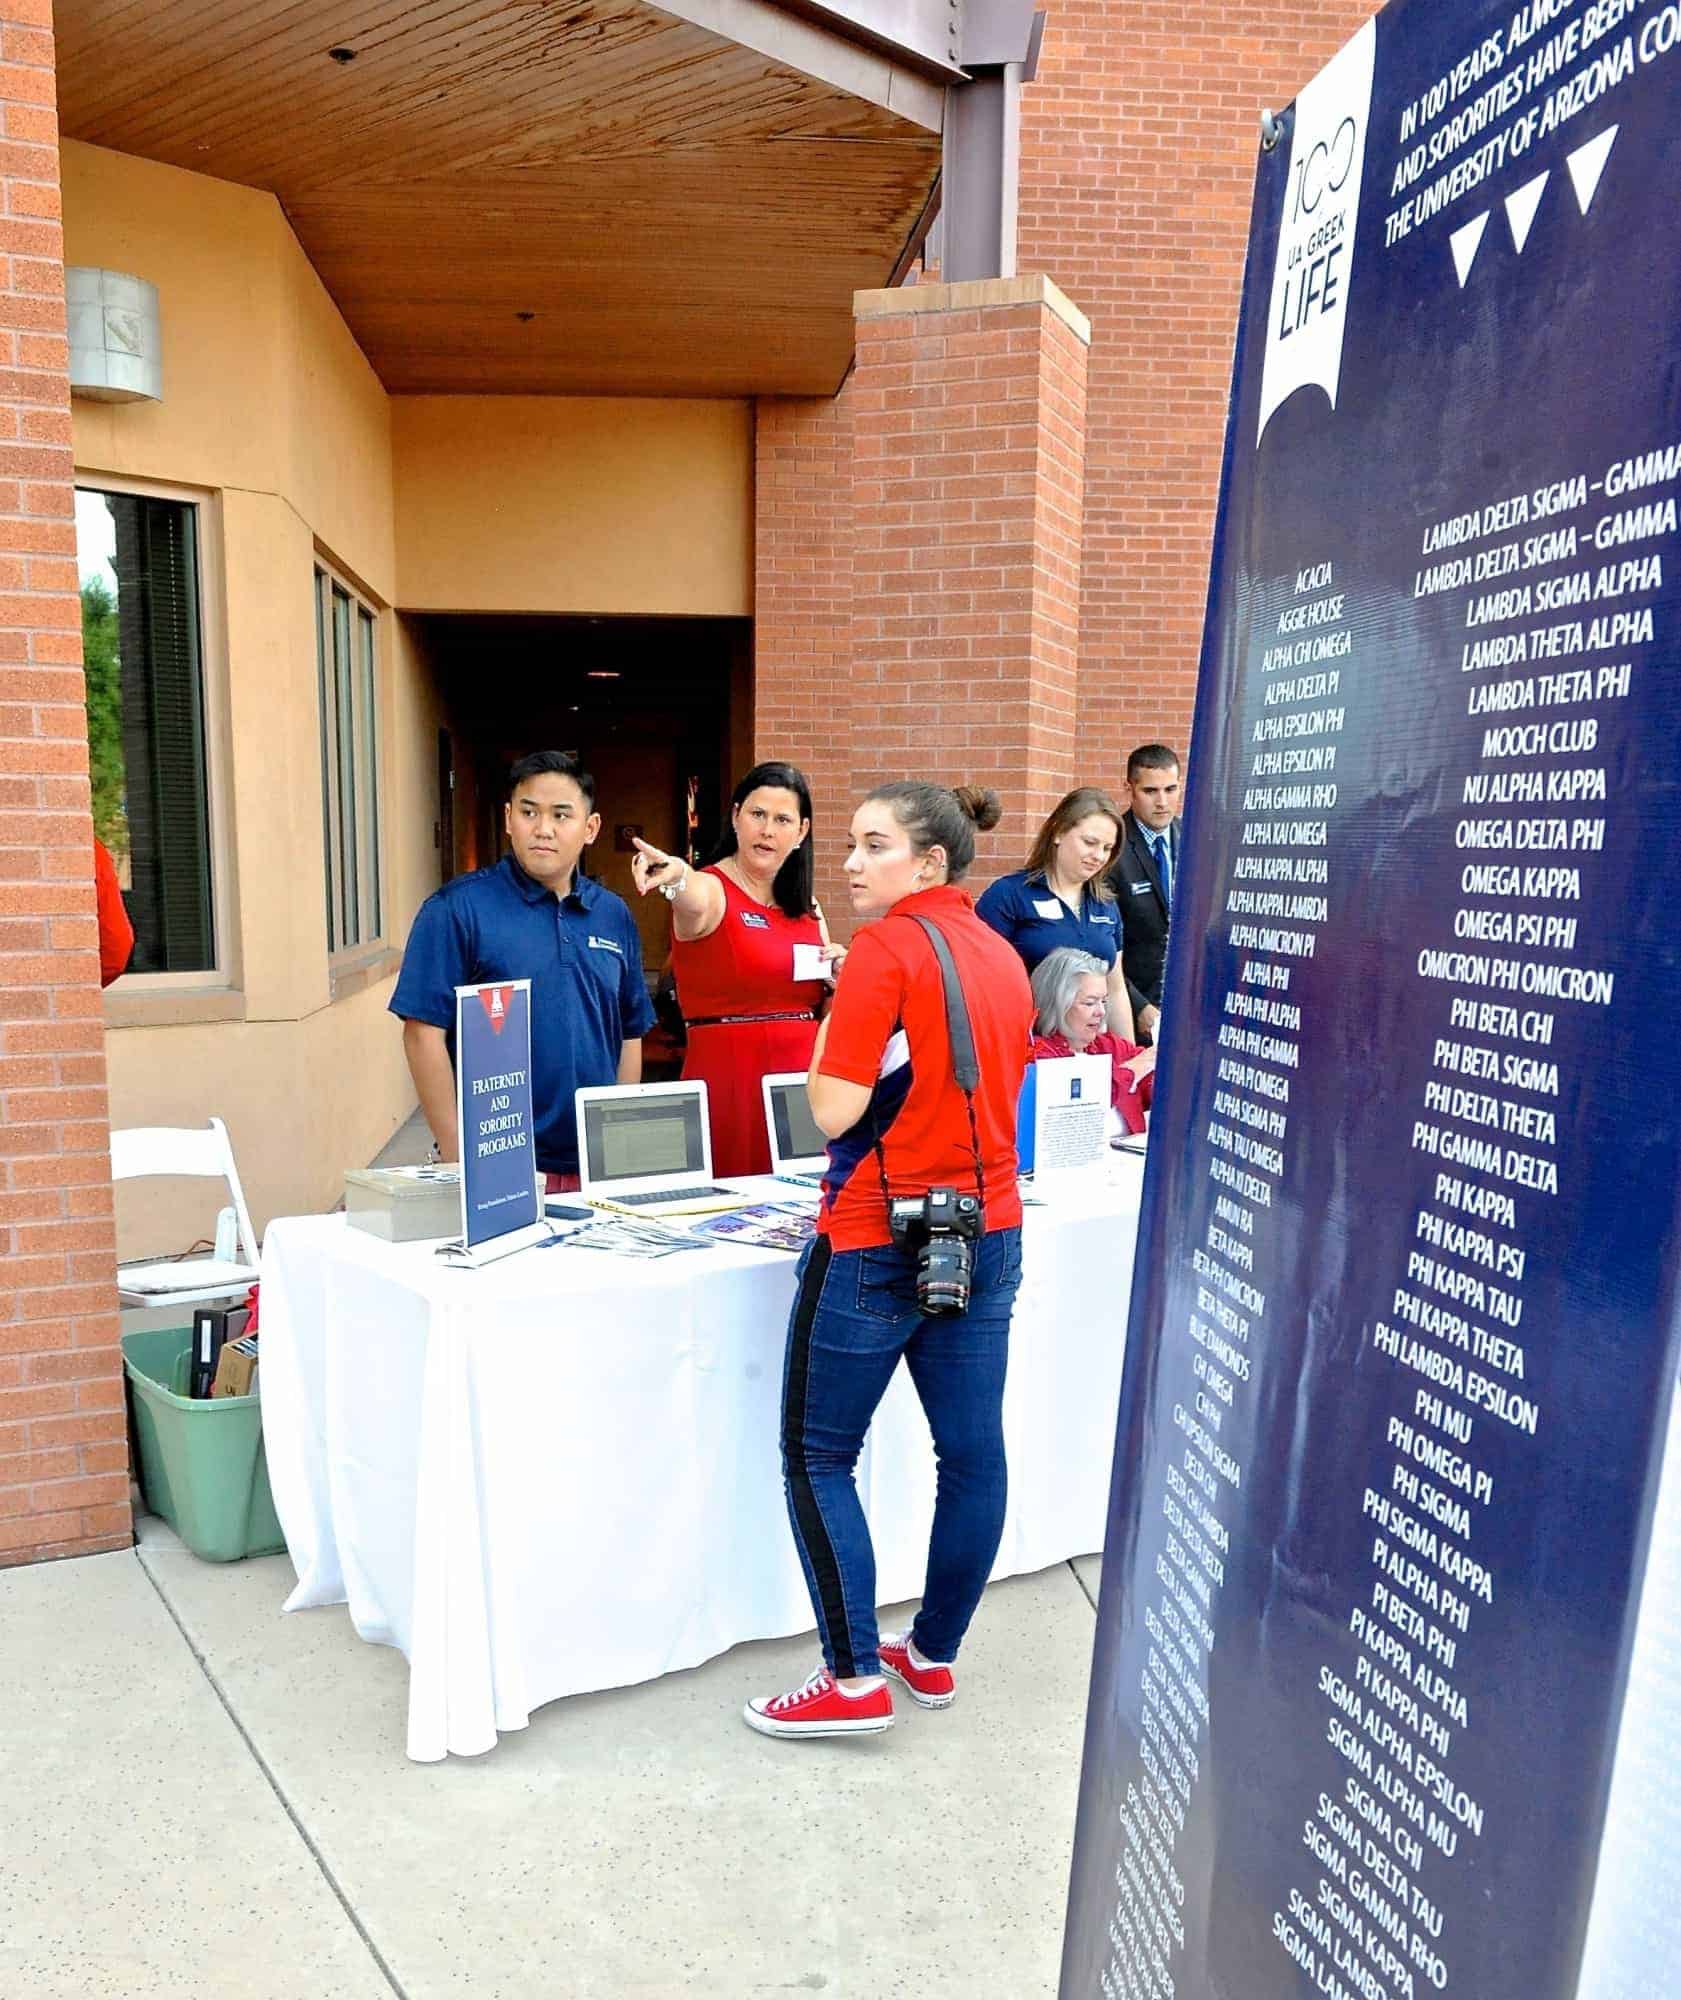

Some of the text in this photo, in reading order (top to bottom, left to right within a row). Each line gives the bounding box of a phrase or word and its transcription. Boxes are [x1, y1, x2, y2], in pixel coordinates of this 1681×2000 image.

[1391, 144, 1426, 197] AND
[1427, 64, 1524, 169] SORORITIES
[1526, 19, 1581, 93] HAVE
[1400, 101, 1417, 143] IN
[1421, 78, 1447, 126] 100
[1450, 30, 1504, 101] YEARS,
[1385, 0, 1681, 248] THE UNIVERSITY OF ARIZONA CO
[1307, 210, 1346, 256] GREEK
[1280, 243, 1343, 340] LIFE
[1422, 510, 1480, 554] LAMBDA
[1482, 494, 1528, 535] DELTA
[1530, 474, 1586, 520] SIGMA
[1414, 498, 1676, 598] LAMBDA DELTA SIGMA GAMMA
[1293, 561, 1331, 594] ACACIA
[1465, 554, 1661, 627] LAMBDA SIGMA ALPHA
[1276, 594, 1344, 635] AGGIE HOUSE
[1461, 608, 1653, 671] LAMBDA THETA ALPHA
[1261, 630, 1351, 672] ALPHA CHI OMEGA
[1263, 670, 1339, 705] ALPHA DELTA PI
[1468, 663, 1631, 714] LAMBDA THETA PHI
[1252, 707, 1344, 741] ALPHA EPSILON PHI
[1481, 718, 1597, 757] MOOCH CLUB
[1251, 746, 1336, 775] ALPHA EPSILON PI
[1462, 768, 1605, 803] NU ALPHA KAPPA
[1242, 783, 1337, 809] ALPHA GAMMA RHO
[1241, 822, 1271, 844] ALPHA
[1288, 821, 1326, 845] OMEGA
[1455, 819, 1605, 849] OMEGA DELTA PHI
[1233, 856, 1327, 883] ALPHA KAPPA ALPHA
[1461, 864, 1579, 899] OMEGA KAPPA
[1226, 890, 1327, 921] ALPHA KAPPA LAMBDA
[1454, 909, 1577, 948] OMEGA PSI PHI
[1228, 923, 1315, 957] ALPHA OMICRON PI
[1241, 960, 1289, 989] ALPHA PHI
[1417, 949, 1613, 1004] OMICRON PHI OMICRON
[1450, 997, 1553, 1044] PHI BETA CHI
[472, 1071, 526, 1095] FRATERNITY
[491, 1095, 510, 1112] AND
[479, 1112, 523, 1136] SORORITY
[1424, 1081, 1555, 1144] PHI DELTA THETA
[478, 1132, 526, 1158] PROGRAMS
[1411, 1121, 1557, 1194] PHI GAMMA DELTA
[1434, 1173, 1514, 1228] PHI KAPPA
[1407, 1251, 1522, 1326] PHI KAPPA TAU
[1393, 1289, 1523, 1378] PHI KAPPA THETA
[1373, 1322, 1538, 1434] PHI LAMBDA EPSILON
[1414, 1389, 1472, 1443] PHI MU
[1387, 1416, 1492, 1504] PHI OMEGA PI
[1392, 1464, 1469, 1539] PHI SIGMA
[1362, 1487, 1491, 1603] PHI SIGMA KAPPA
[1372, 1538, 1469, 1632] PI ALPHA PHI
[1349, 1607, 1466, 1728] PI KAPPA ALPHA
[1355, 1655, 1449, 1755] PI KAPPA PHI
[1318, 1666, 1483, 1835] SIGMA ALPHA EPSILON
[1326, 1717, 1457, 1856] SIGMA ALPHA MU
[1344, 1777, 1422, 1871] SIGMA CHI
[1317, 1792, 1443, 1937] SIGMA DELTA TAU
[1287, 1888, 1331, 1953] SIGMA
[1302, 1820, 1447, 1988] SIGMA GAMMA RHO
[1317, 1878, 1413, 2000] SIGMA KAPPA
